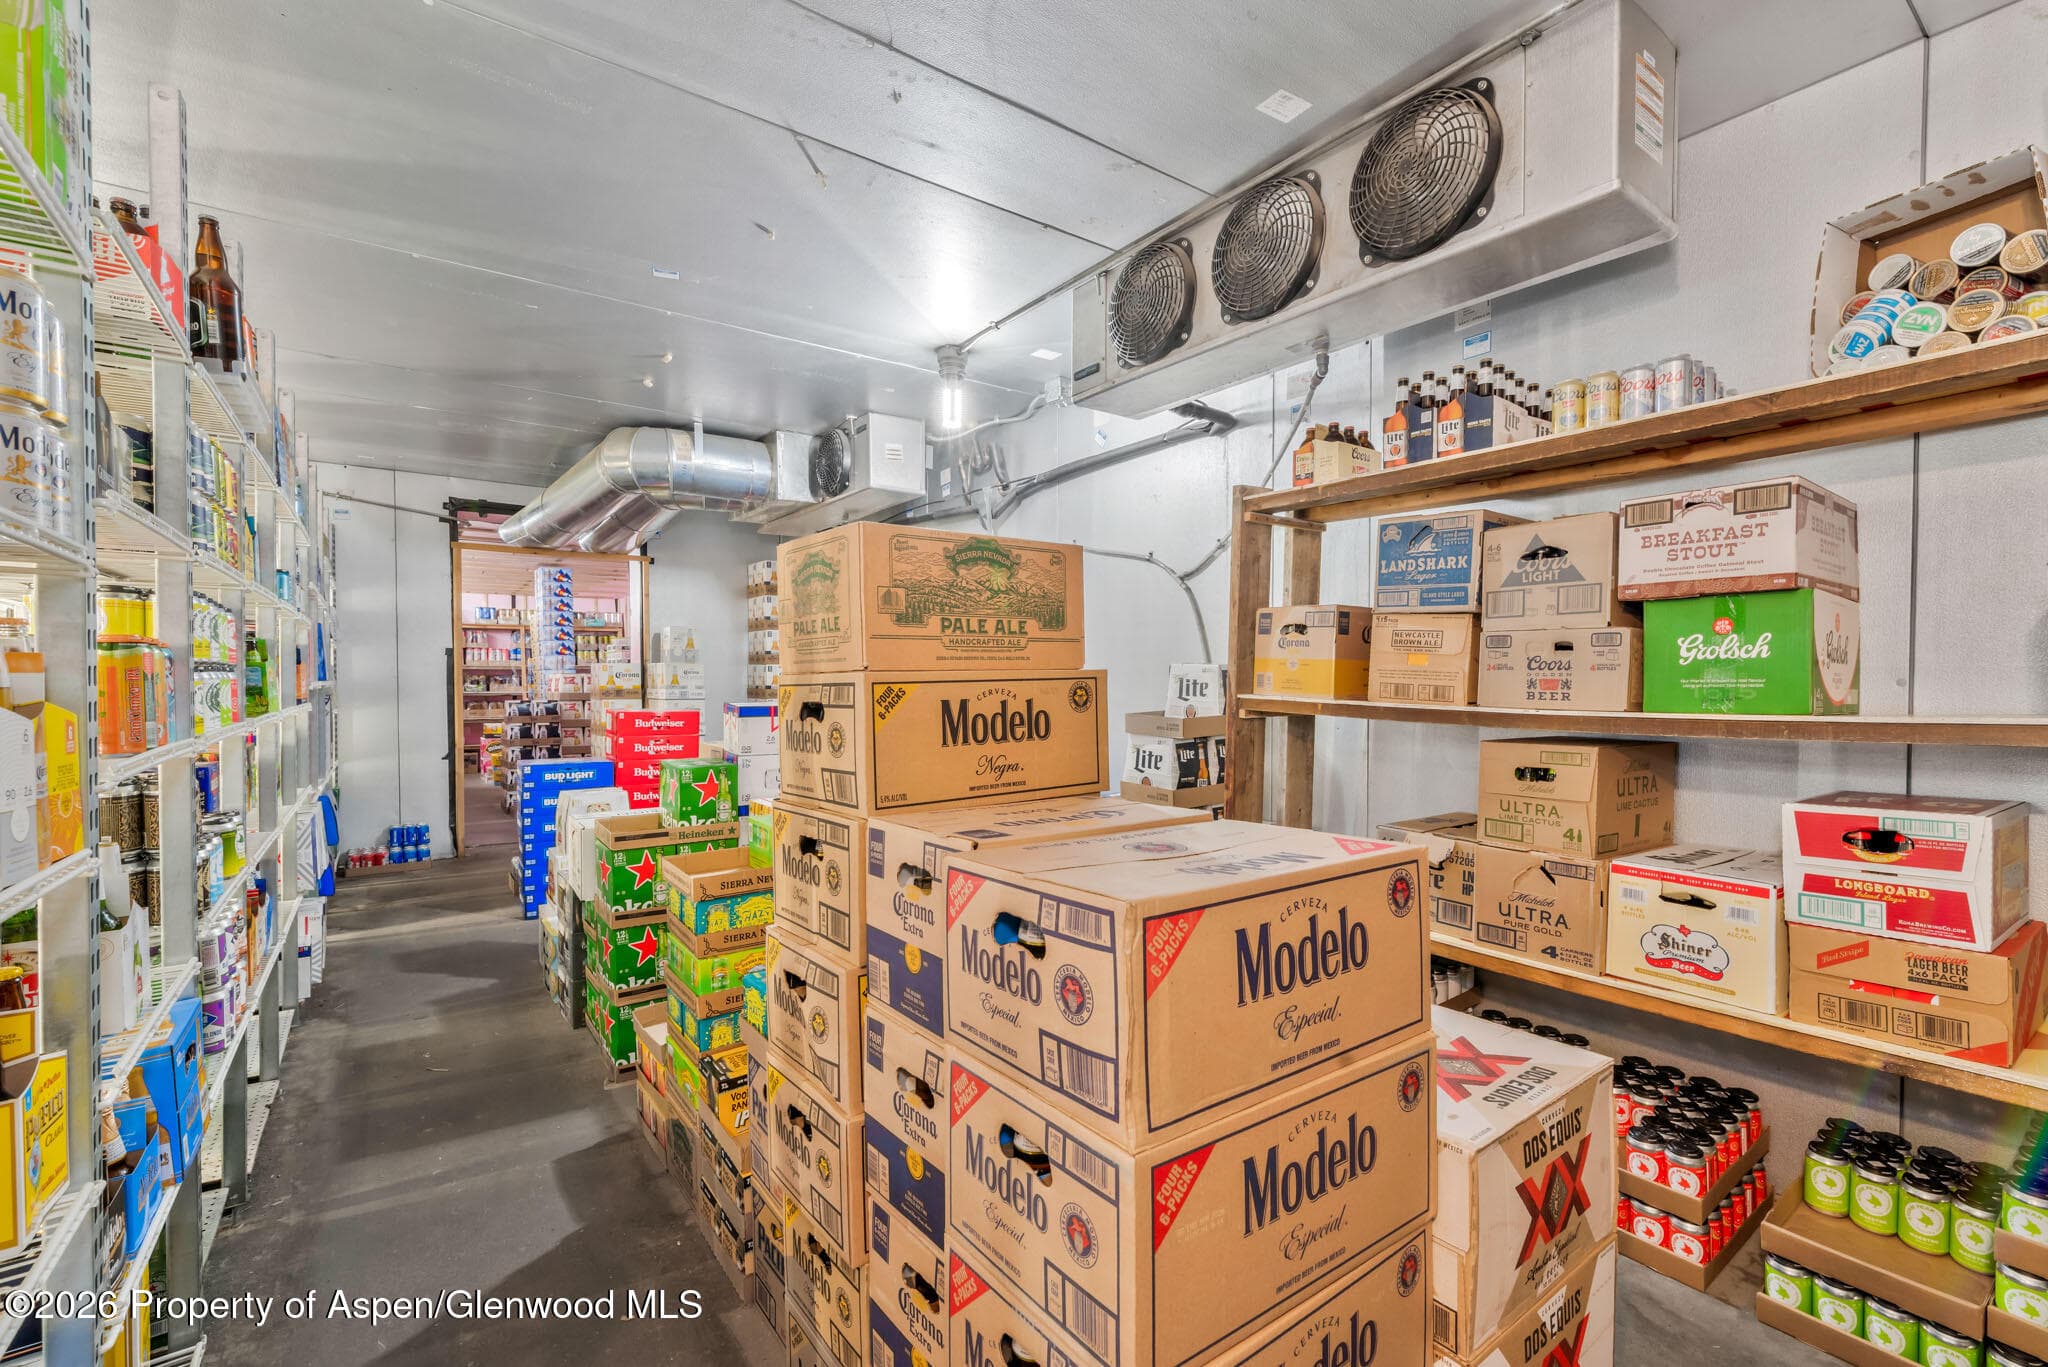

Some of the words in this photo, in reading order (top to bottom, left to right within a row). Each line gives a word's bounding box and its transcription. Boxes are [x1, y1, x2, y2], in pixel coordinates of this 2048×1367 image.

[1904, 313, 1938, 325] ZYN
[1854, 334, 1870, 355] ZYN
[1441, 421, 1459, 435] Lite
[1504, 407, 1521, 431] Lite
[1386, 432, 1404, 445] Lite
[1352, 447, 1370, 462] Coors
[1641, 522, 1769, 550] BREAKFAST
[956, 550, 983, 562] SIERRA
[983, 550, 1011, 566] NEVADA
[1666, 543, 1738, 562] STOUT
[1381, 556, 1468, 573] LANDSHARK
[1405, 570, 1437, 584] Lager
[1522, 569, 1560, 583] LIGHT
[794, 621, 817, 637] PALE
[821, 616, 840, 633] ALE
[940, 617, 988, 634] PALE
[994, 620, 1028, 635] ALE
[1278, 635, 1310, 649] Corona
[1677, 633, 1772, 665] Grolsch
[1826, 630, 1849, 670] Grolsch
[1527, 656, 1571, 671] Coors
[615, 671, 640, 679] Corona
[876, 686, 895, 707] FOUR
[977, 688, 1017, 701] CERVEZA
[1177, 677, 1209, 701] Lite
[1526, 692, 1571, 701] BEER
[634, 719, 684, 731] Budweiser
[941, 697, 1051, 747] Modelo
[786, 720, 822, 753] Modelo
[634, 744, 684, 755] Budweiser
[1180, 749, 1195, 762] Lite
[1134, 748, 1163, 773] Lite
[544, 772, 565, 782] BUD
[566, 771, 594, 781] LIGHT
[1616, 776, 1658, 797] ULTRA
[1500, 799, 1561, 819] ULTRA
[1616, 800, 1631, 812] LIME
[1633, 797, 1659, 810] CACTUS
[1499, 813, 1520, 821] LIME
[1521, 816, 1561, 828] CACTUS
[678, 829, 724, 840] Heineken
[1563, 828, 1575, 841] 4
[782, 843, 820, 887] Modelo
[720, 877, 754, 890] SIERRA
[757, 875, 773, 884] NEV
[1463, 870, 1474, 883] LN
[1462, 884, 1474, 896] HP
[1834, 879, 1930, 900] LONGBOARD
[1855, 891, 1880, 901] Island
[1882, 895, 1907, 904] Lager
[893, 890, 935, 927] Corona
[1508, 892, 1555, 908] Michelob
[744, 908, 770, 922] HAZY
[1280, 898, 1328, 922] CERVEZA
[1499, 902, 1569, 929] ULTRA
[900, 915, 924, 939] Extra
[1503, 920, 1530, 931] PURE
[1533, 926, 1562, 937] GOLD
[723, 932, 757, 944] SIERRA
[1148, 919, 1174, 956] FOUR
[1657, 932, 1712, 957] Shiner
[1727, 932, 1757, 942] ALC/VOL
[1151, 919, 1189, 978] 6-PACKS
[1235, 906, 1369, 1008] Modelo
[1541, 945, 1559, 959] 4
[1663, 950, 1704, 964] Premium
[1821, 953, 1839, 963] Red
[1839, 947, 1865, 959] Stripe
[1904, 951, 1969, 965] Jamaican
[962, 925, 1042, 1006] Modelo
[1559, 958, 1593, 968] BOTTLES
[1671, 960, 1695, 973] Beer
[1907, 957, 1939, 972] LAGER
[1942, 962, 1969, 977] BEER
[1907, 969, 1929, 978] 4x6
[1932, 972, 1968, 984] PACK
[1271, 1056, 1296, 1072] IMPORTED
[1296, 1051, 1308, 1062] BEER
[1309, 1046, 1323, 1057] FROM
[1324, 1038, 1340, 1052] MEXICO
[1517, 1066, 1557, 1084] DOS
[731, 1090, 749, 1101] VOO
[1482, 1080, 1535, 1107] EQUIS
[731, 1101, 749, 1113] RAN
[893, 1090, 938, 1139] Corona
[1541, 1106, 1565, 1125] CERVEZA
[734, 1113, 749, 1129] IP
[1288, 1110, 1337, 1142] CERVEZA
[775, 1104, 810, 1169] Modelo
[901, 1118, 926, 1148] Extra
[1523, 1130, 1548, 1169] DOS
[1550, 1108, 1581, 1152] EQUIS
[966, 1124, 1047, 1233] Modelo
[1243, 1112, 1377, 1238] Modelo
[1156, 1164, 1182, 1206] FOUR
[1160, 1161, 1198, 1226] 6-PACKS
[1514, 1132, 1592, 1270] XX
[792, 1234, 831, 1303] Modelo
[1276, 1276, 1300, 1294] IMPORTED
[1301, 1268, 1314, 1280] BEER
[1314, 1260, 1328, 1273] FROM
[1329, 1247, 1346, 1263] MEXICO
[899, 1287, 944, 1349] Corona
[1525, 1322, 1547, 1363] DOS
[1550, 1289, 1580, 1339] EQUIS
[906, 1316, 932, 1354] Extra
[1294, 1316, 1340, 1357] CERVEZA
